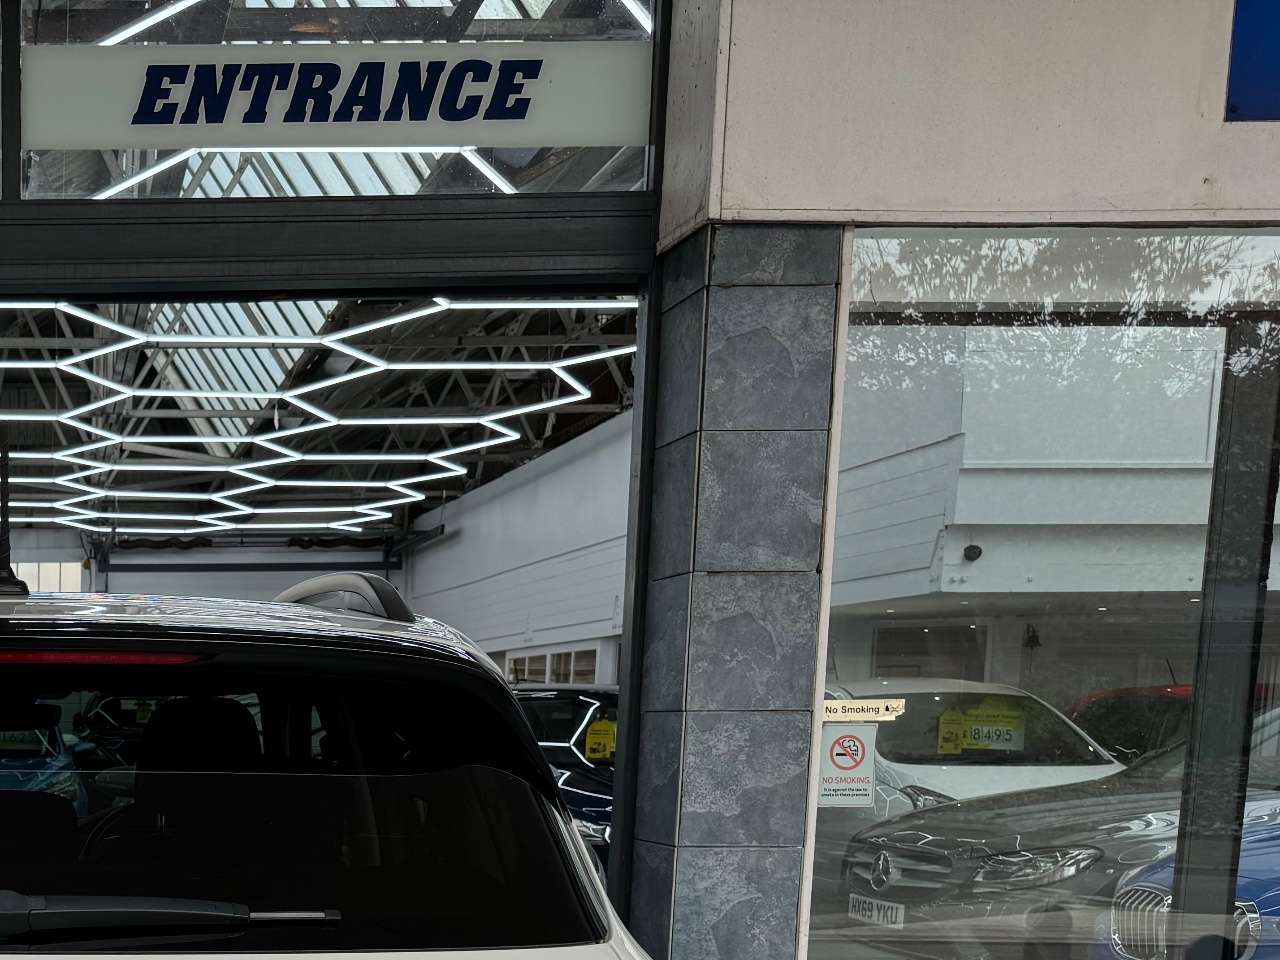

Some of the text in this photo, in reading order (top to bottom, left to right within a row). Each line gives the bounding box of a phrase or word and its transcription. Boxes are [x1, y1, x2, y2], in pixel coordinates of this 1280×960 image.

[131, 59, 544, 126] ENTRANCE
[825, 705, 880, 714] No Smoking
[822, 776, 834, 784] NO
[876, 903, 898, 924] YKU
